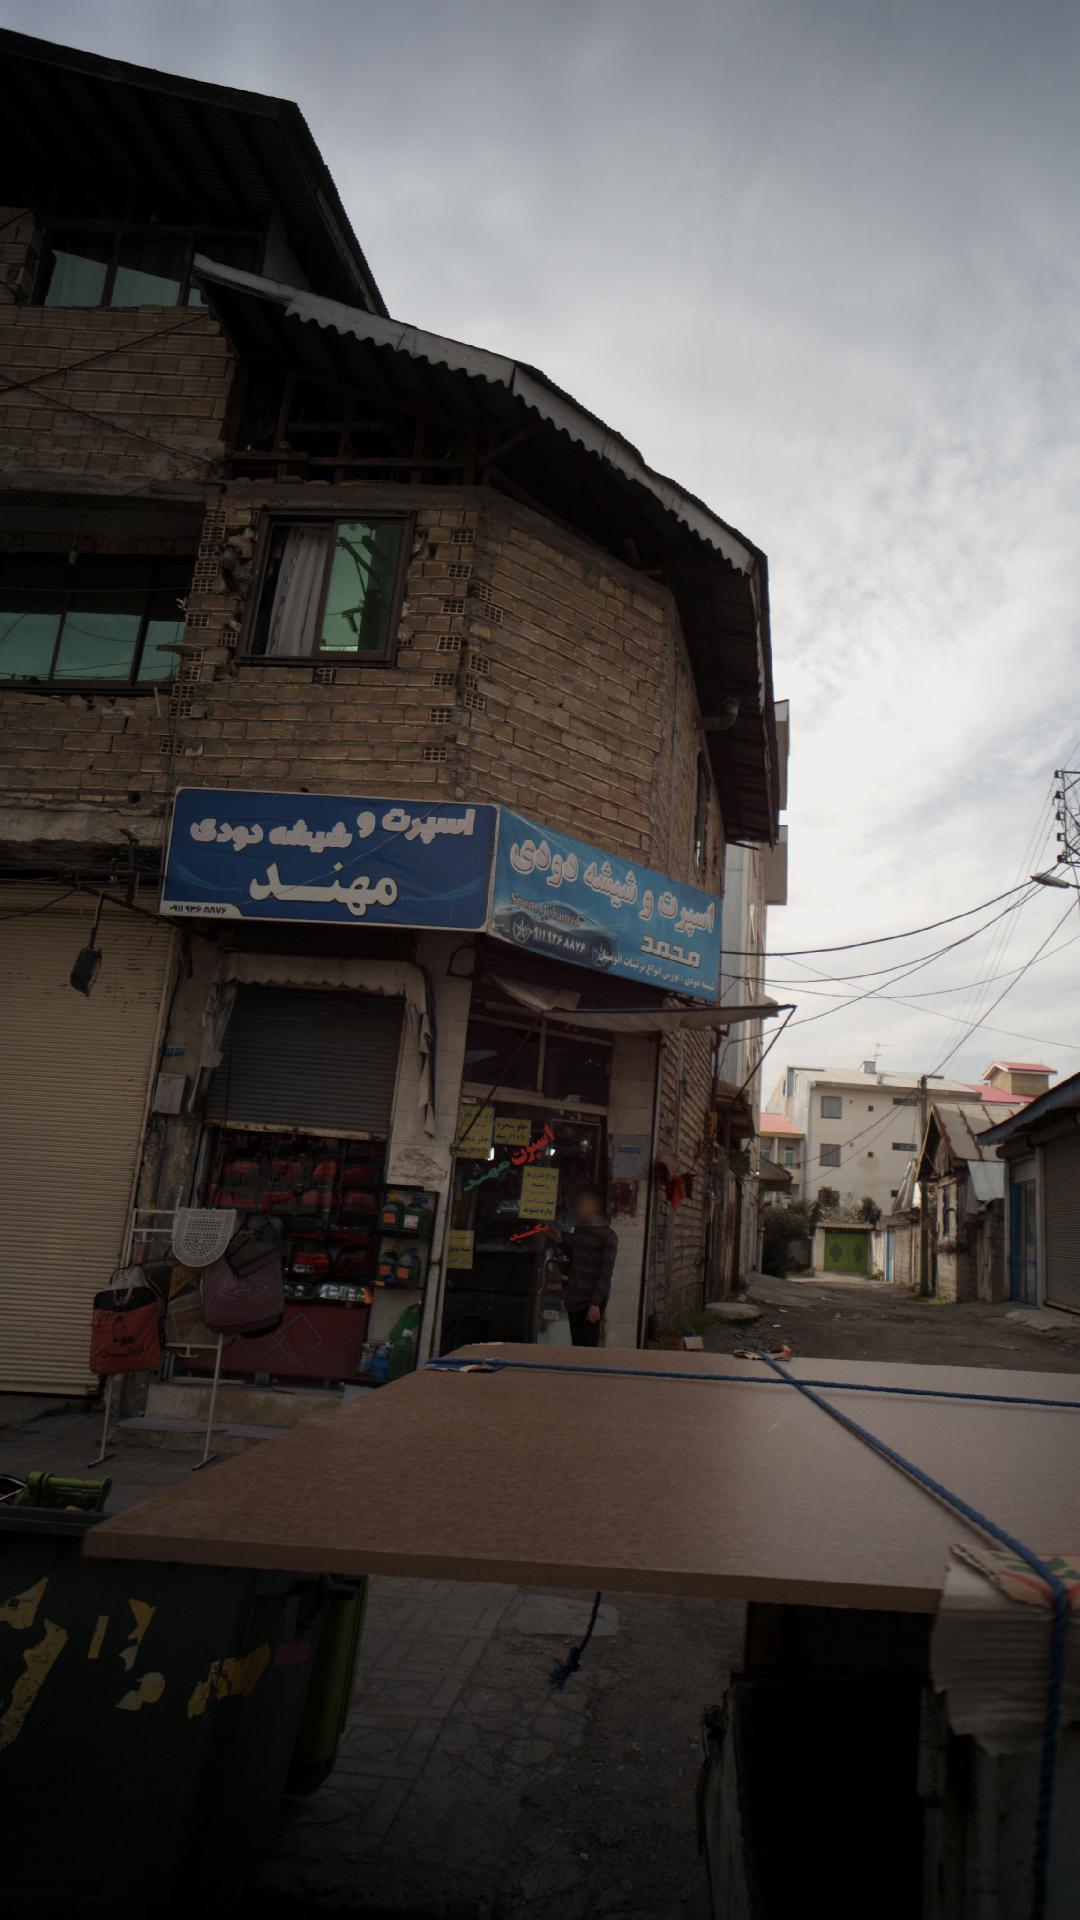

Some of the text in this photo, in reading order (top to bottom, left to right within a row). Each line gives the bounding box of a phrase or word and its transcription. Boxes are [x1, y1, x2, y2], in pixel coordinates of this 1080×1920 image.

[189, 808, 476, 854] اسپرت و شیشه دودی
[249, 861, 398, 917] مهند
[510, 838, 715, 938] اسپرت و شیشه دودی
[640, 933, 702, 968] محمد
